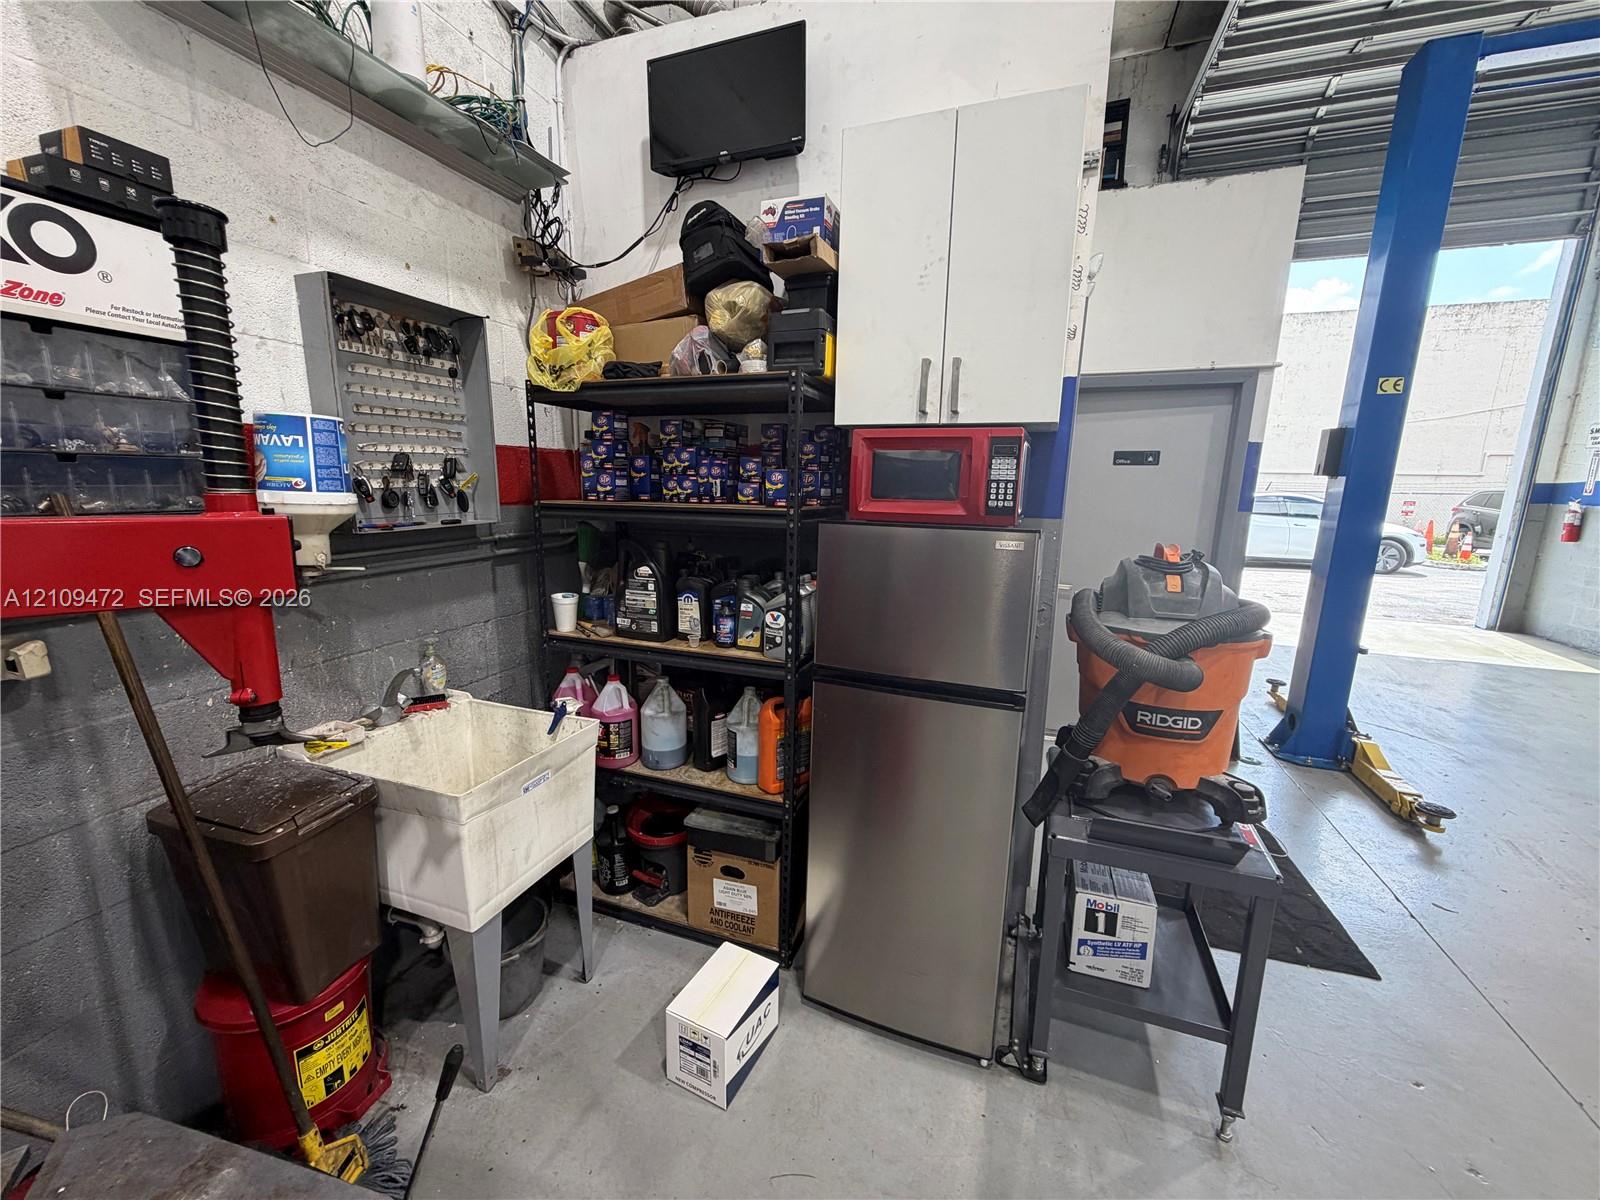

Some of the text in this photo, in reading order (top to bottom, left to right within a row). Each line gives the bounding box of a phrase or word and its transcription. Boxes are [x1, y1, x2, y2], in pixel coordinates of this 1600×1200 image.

[85, 307, 106, 316] Please
[107, 311, 131, 321] Contact
[132, 316, 145, 324] Your
[146, 318, 160, 326] Local
[122, 306, 145, 316] Restock
[1379, 378, 1404, 393] CE
[1136, 711, 1202, 730] RIDGID
[1086, 898, 1120, 913] Mobil
[709, 907, 756, 926] ANTIFREEZE
[709, 916, 756, 935] AND COOLANT
[1095, 912, 1106, 934] 1
[325, 1010, 359, 1044] JUSTRITE
[746, 1001, 772, 1046] UAC
[315, 1057, 335, 1079] EMPTY
[336, 1044, 352, 1065] EVERY
[675, 1076, 717, 1101] NEW COMPRESSOR
